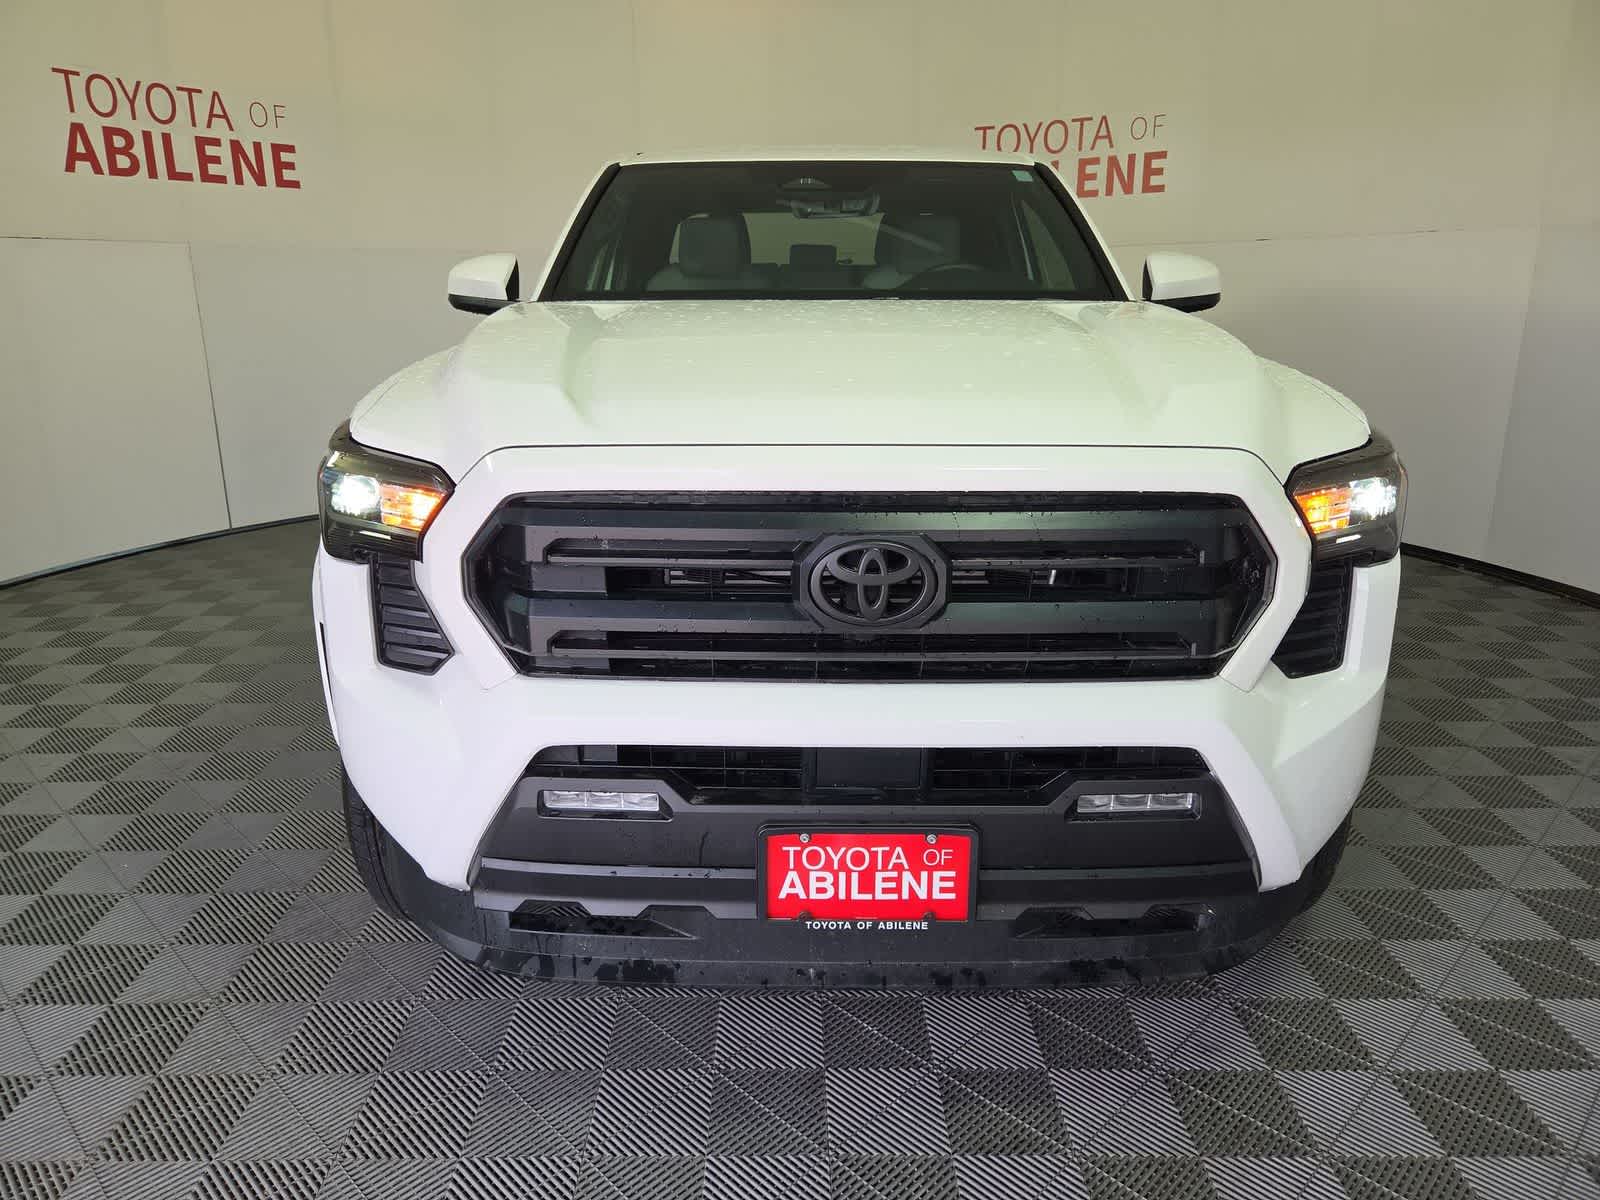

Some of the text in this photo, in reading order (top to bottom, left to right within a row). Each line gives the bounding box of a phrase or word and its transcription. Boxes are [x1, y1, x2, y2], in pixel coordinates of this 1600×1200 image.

[51, 67, 286, 132] TOYOTA OF
[974, 114, 1166, 154] TOYOTA OF
[64, 122, 302, 189] ABILENE
[782, 846, 953, 870] TOYOTA OF
[778, 870, 956, 900] ABILENE
[806, 921, 928, 930] TOYOTA OF ABILENE
